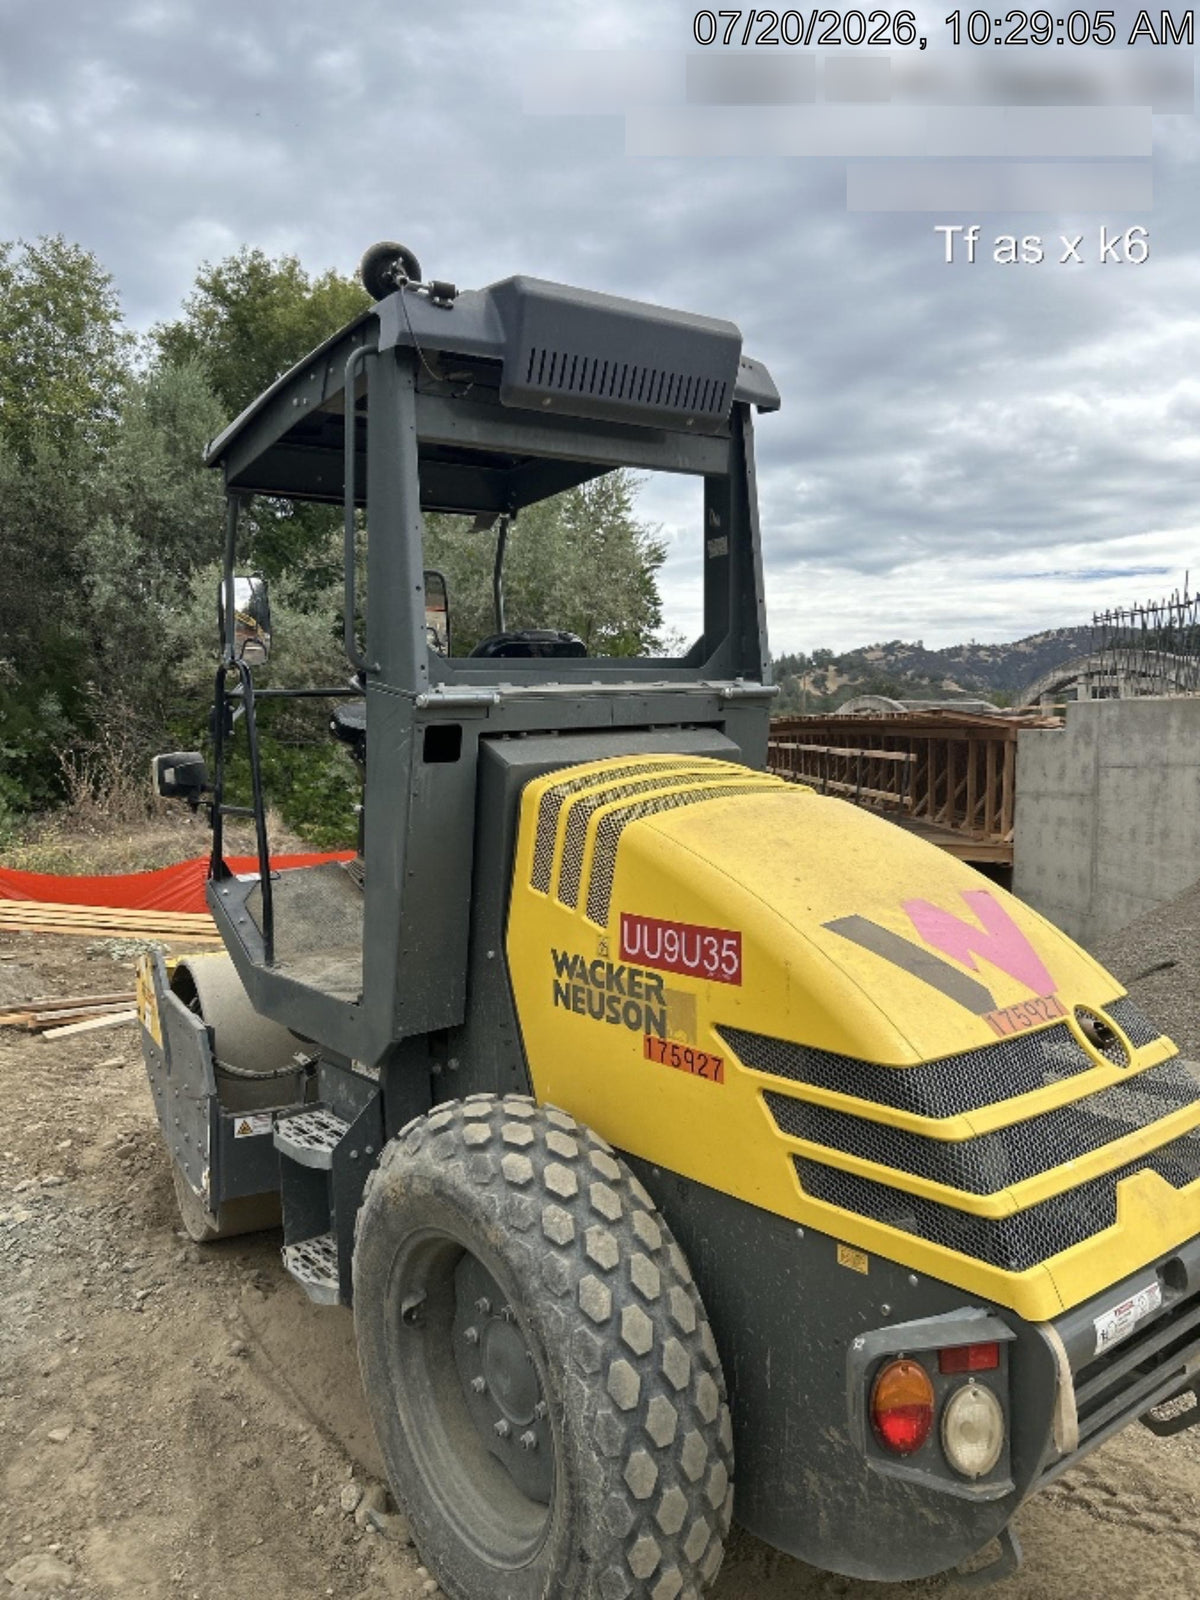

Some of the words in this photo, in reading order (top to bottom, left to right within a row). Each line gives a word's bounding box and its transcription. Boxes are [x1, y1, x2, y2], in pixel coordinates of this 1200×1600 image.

[622, 919, 740, 976] UU9U35
[551, 948, 667, 1006] WACKER
[552, 978, 667, 1039] NEUSON
[986, 994, 1066, 1036] 175927
[644, 1036, 724, 1083] 175927
